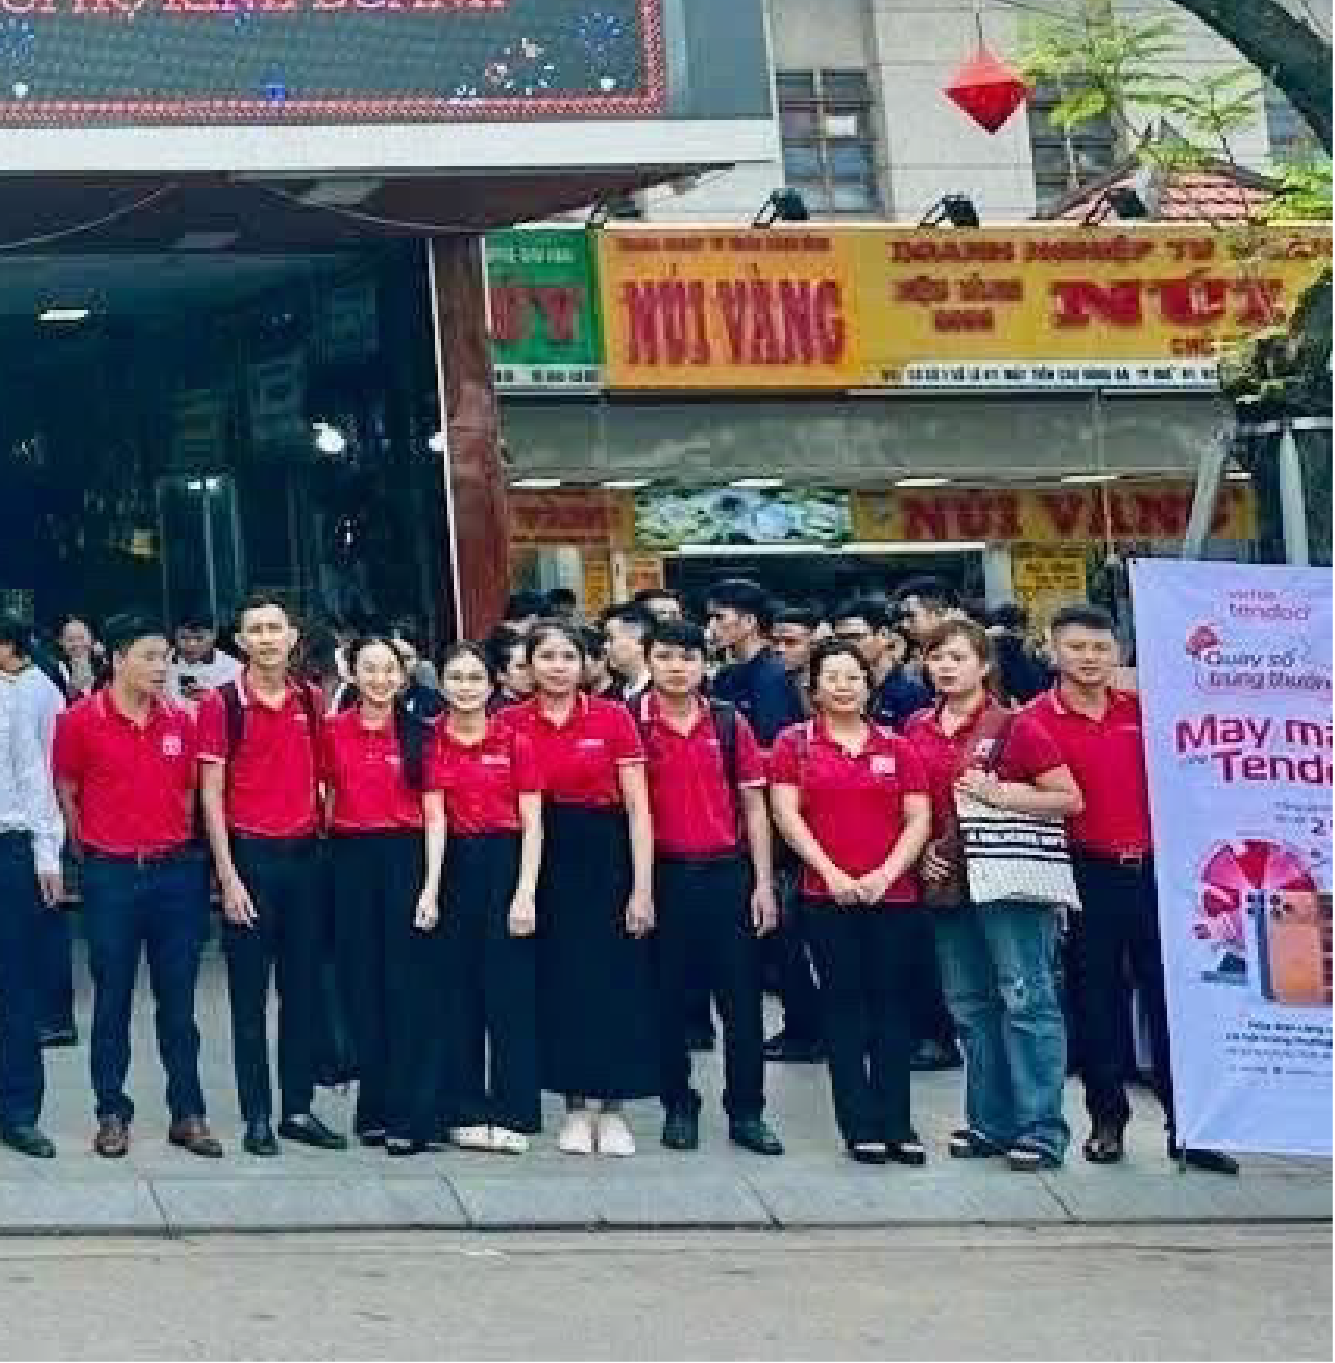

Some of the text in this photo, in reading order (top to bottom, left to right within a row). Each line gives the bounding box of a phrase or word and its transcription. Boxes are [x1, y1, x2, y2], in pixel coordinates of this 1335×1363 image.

[891, 237, 1015, 262] DOANH
[619, 262, 845, 365] NÚI VÀNG
[1175, 714, 1273, 753] May
[1210, 747, 1332, 785] Tend
